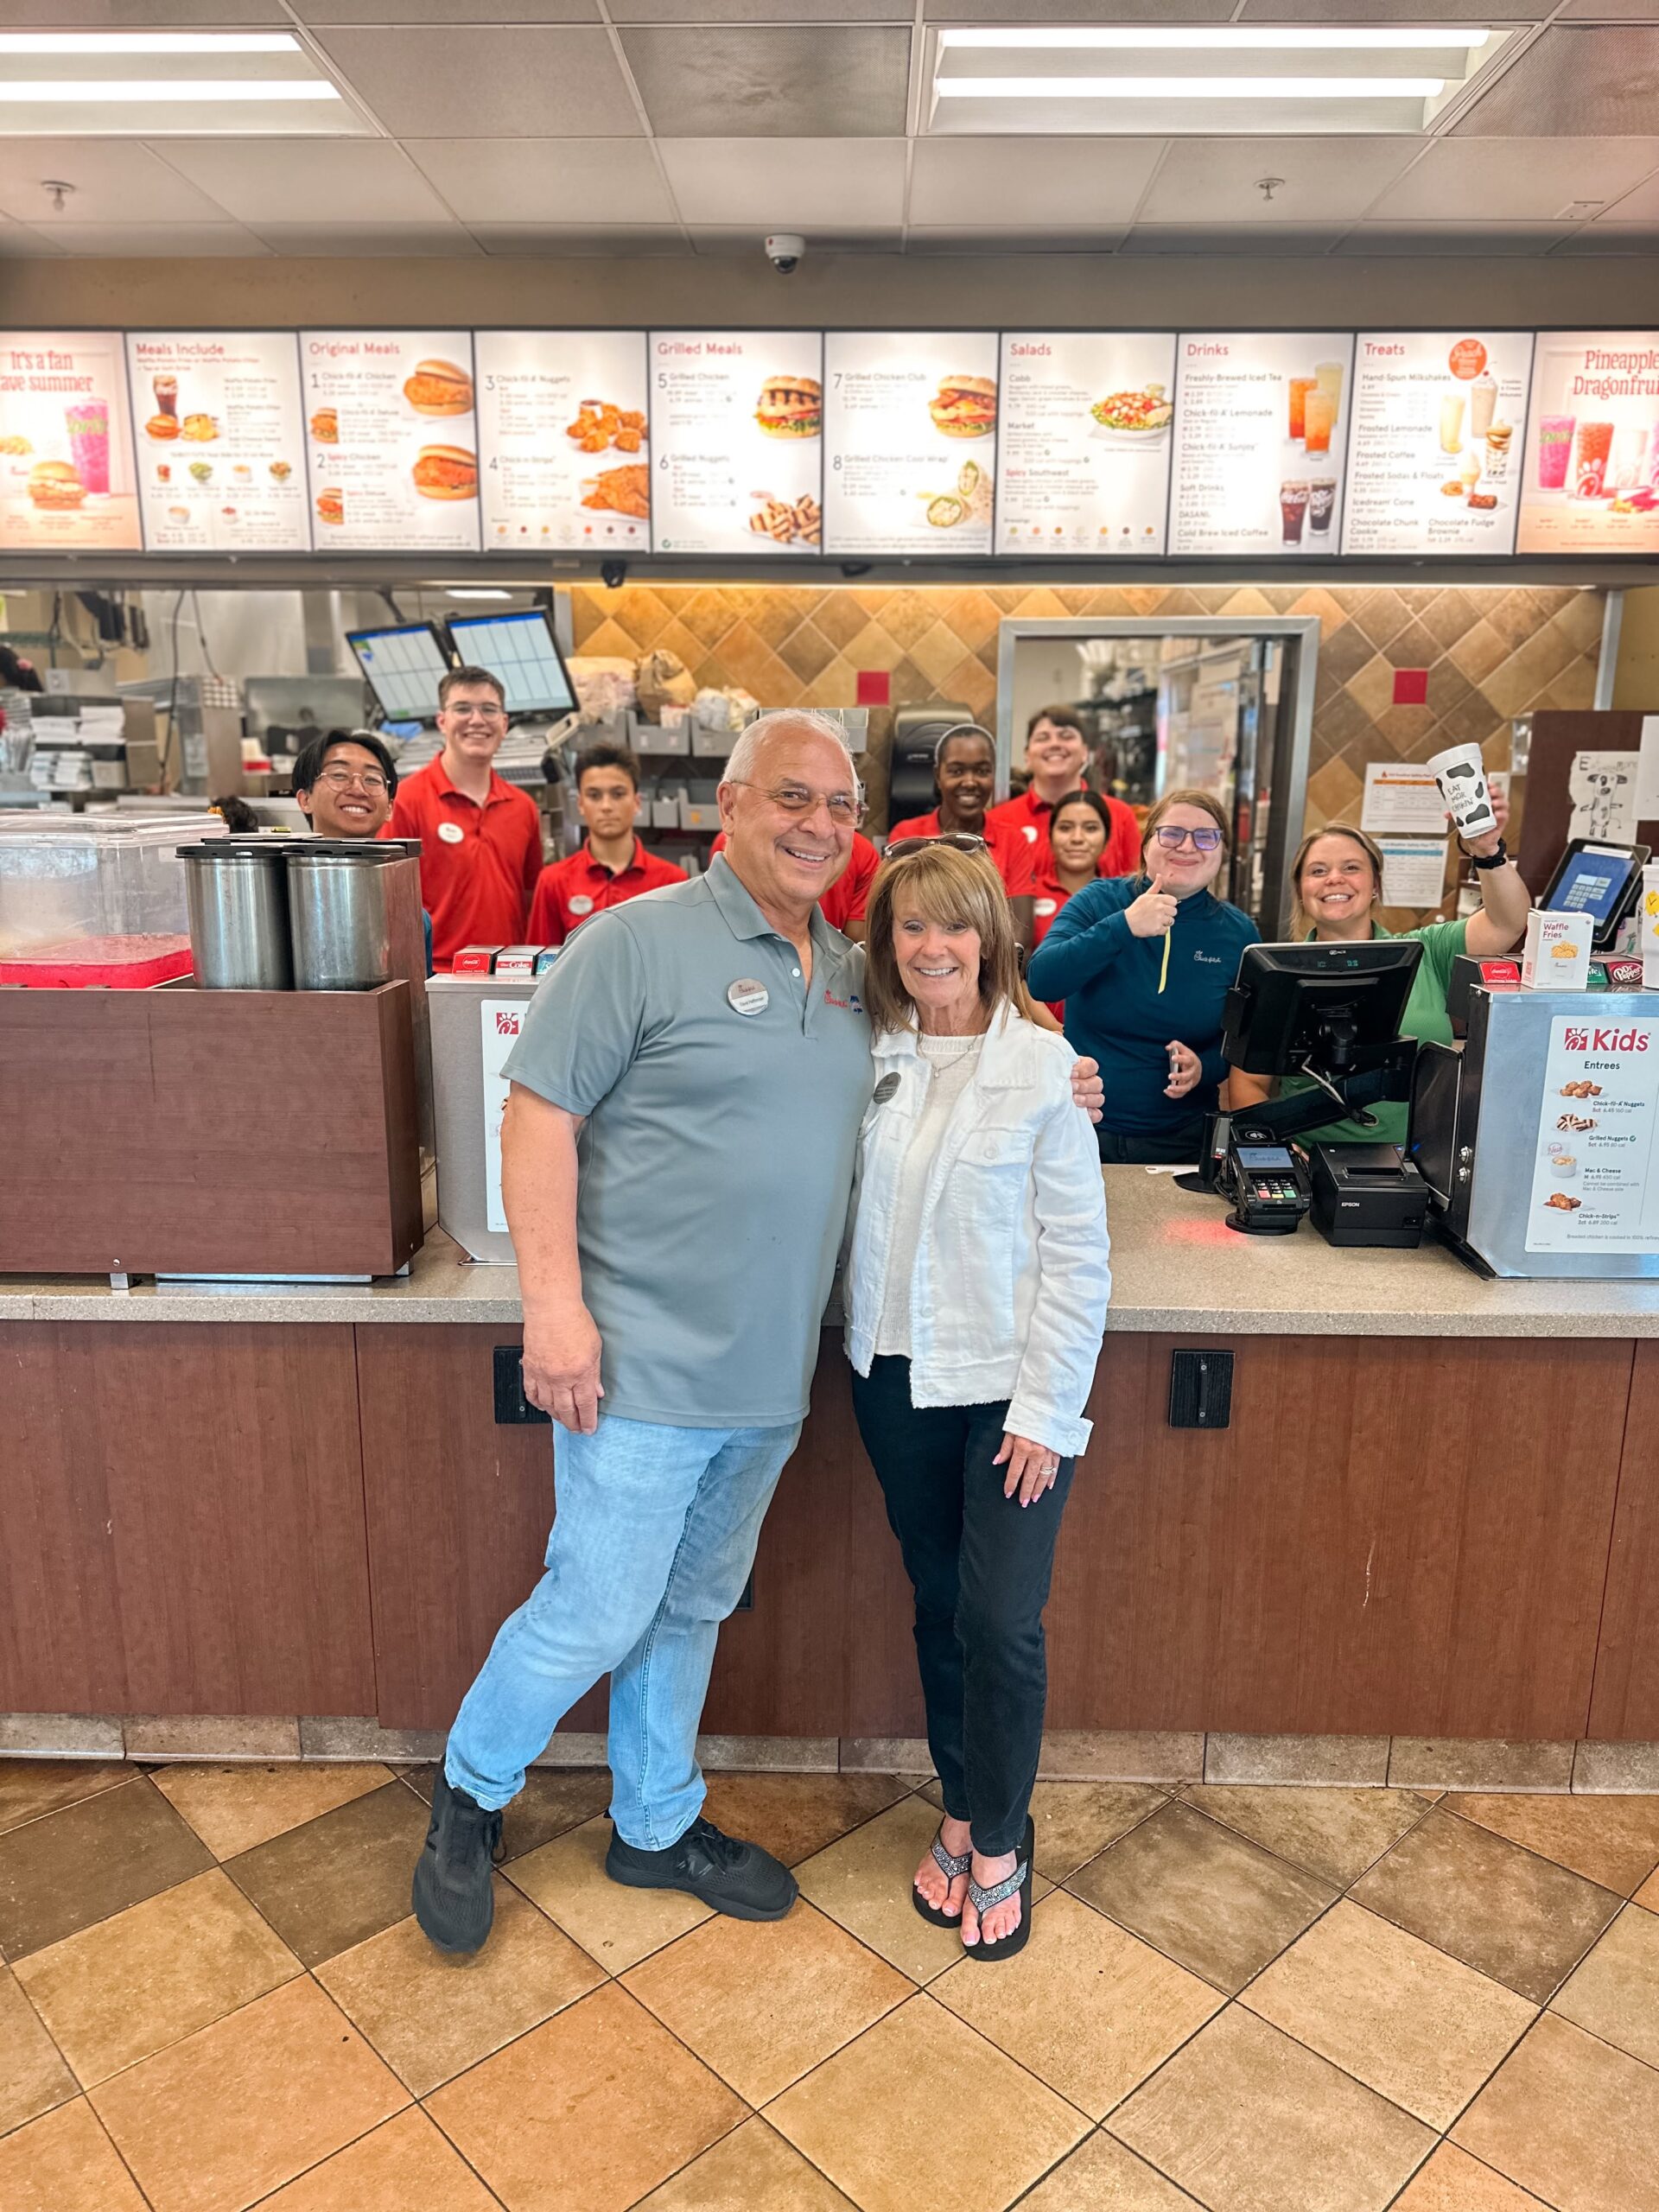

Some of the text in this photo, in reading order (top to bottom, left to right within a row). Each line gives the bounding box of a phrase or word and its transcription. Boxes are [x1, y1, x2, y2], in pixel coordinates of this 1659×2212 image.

[136, 342, 226, 356] Meals Include
[309, 342, 400, 357] Original Meals
[658, 342, 743, 356] Grilled Meals
[1010, 342, 1052, 357] Salads
[1187, 343, 1229, 356] Drinks
[1364, 342, 1405, 356] Treats
[10, 350, 73, 370] It's a fan
[1584, 350, 1659, 374] Pineapple
[0, 375, 93, 391] ave summer
[311, 373, 321, 388] 1
[486, 375, 495, 391] 3
[539, 375, 570, 385] Nuggets
[658, 373, 667, 389] 5
[833, 373, 842, 389] 7
[1009, 374, 1031, 383] Cobb
[1249, 374, 1266, 384] Iced
[1268, 374, 1282, 384] Tea
[1408, 373, 1451, 382] Milkshakes
[1573, 375, 1659, 400] Dragonfrui
[316, 453, 381, 469] 2 Spicy Chicken
[489, 457, 498, 471] 4
[659, 454, 669, 470] 6
[699, 454, 730, 463] Nuggets
[833, 455, 842, 470] 8
[1006, 468, 1026, 477] Spicy
[1428, 518, 1495, 528] Chocolate Fudge
[1447, 784, 1460, 795] EAT
[1452, 792, 1466, 803] MOR
[1613, 967, 1641, 982] Pepper
[1621, 964, 1632, 973] Dr
[1592, 1028, 1649, 1052] Kids
[1584, 1060, 1621, 1071] Entrees
